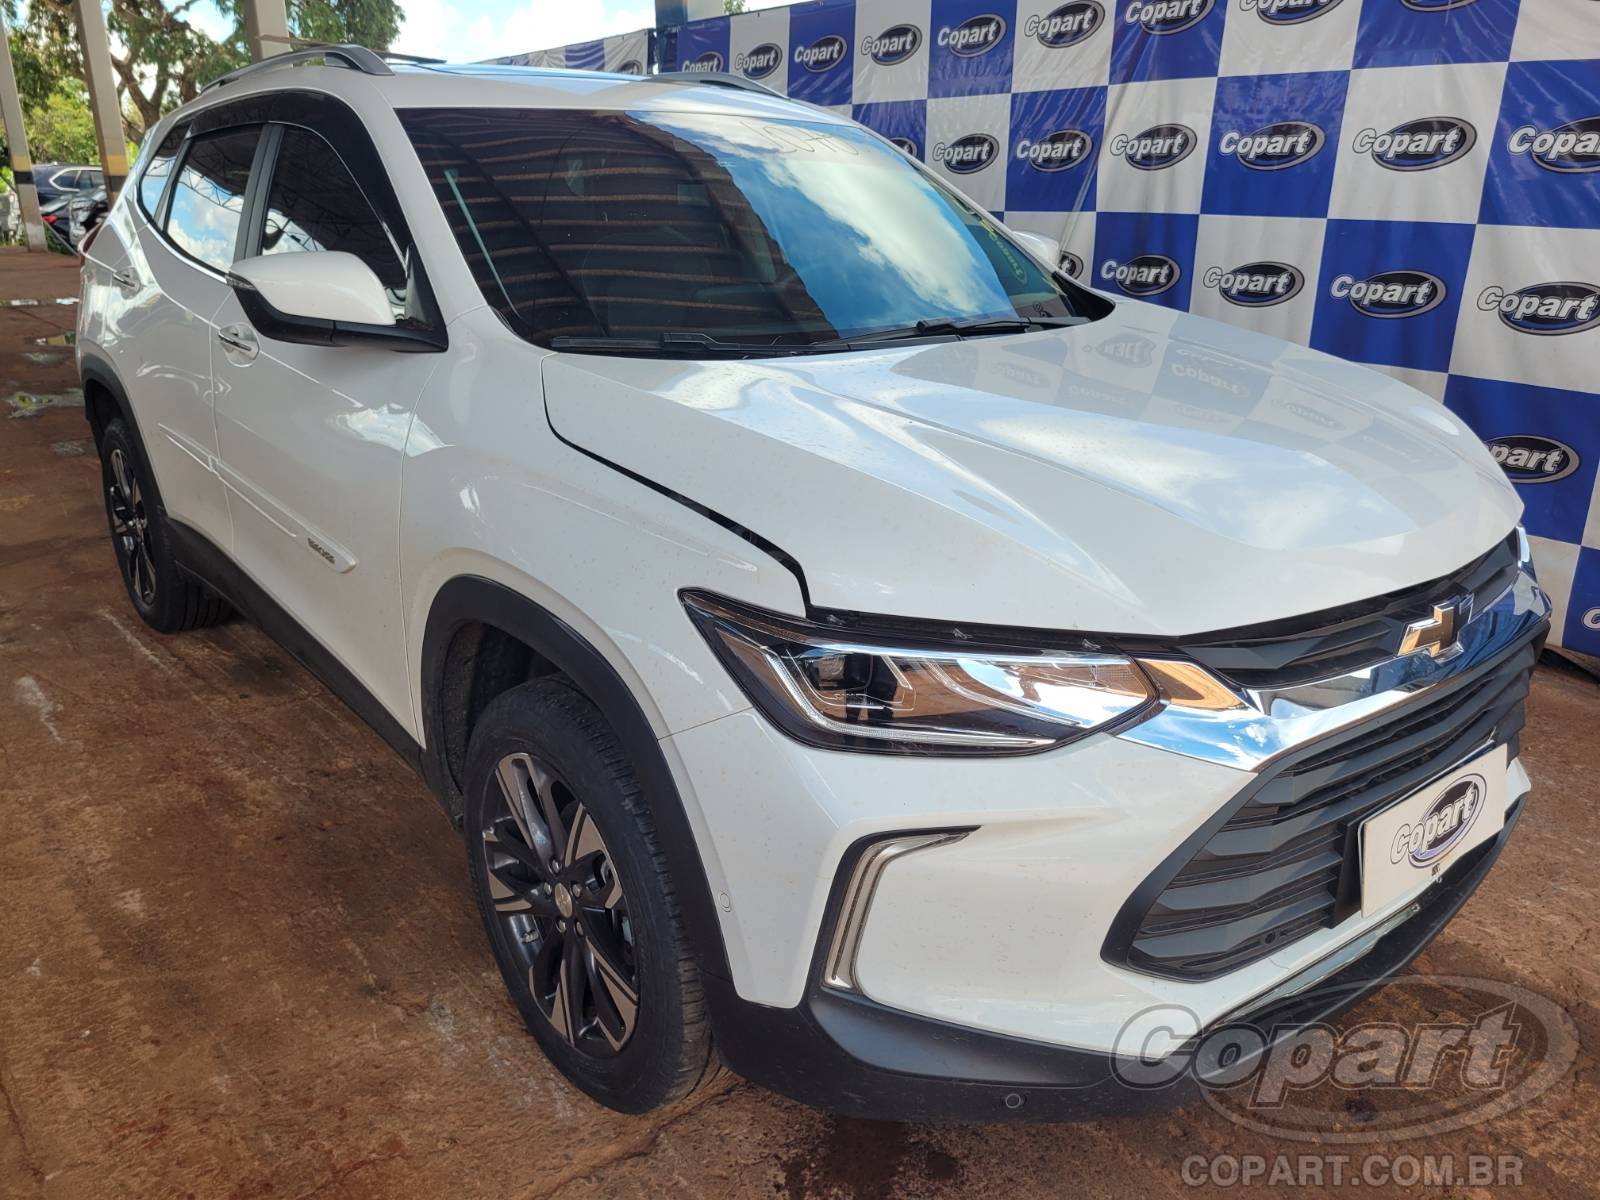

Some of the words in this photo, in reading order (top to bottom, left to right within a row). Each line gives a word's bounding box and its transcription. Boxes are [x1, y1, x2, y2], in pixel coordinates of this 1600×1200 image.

[1024, 10, 1093, 40] Copart
[1125, 0, 1202, 27] Copart
[861, 30, 914, 57] Copart
[937, 18, 998, 49] Copart
[734, 48, 776, 71] Copart
[794, 41, 841, 65] Copart
[933, 139, 991, 168] Copart
[1016, 135, 1083, 162] Copart
[1110, 131, 1183, 160] Copart
[1219, 126, 1312, 160] Copart
[1353, 126, 1461, 160] Copart
[1507, 124, 1600, 161] Copa
[1101, 259, 1171, 285] Copart
[1203, 266, 1291, 296] Copart
[1330, 274, 1433, 307] Copart
[1477, 286, 1600, 322] Copart
[1488, 443, 1564, 474] part
[1390, 781, 1477, 865] Copart
